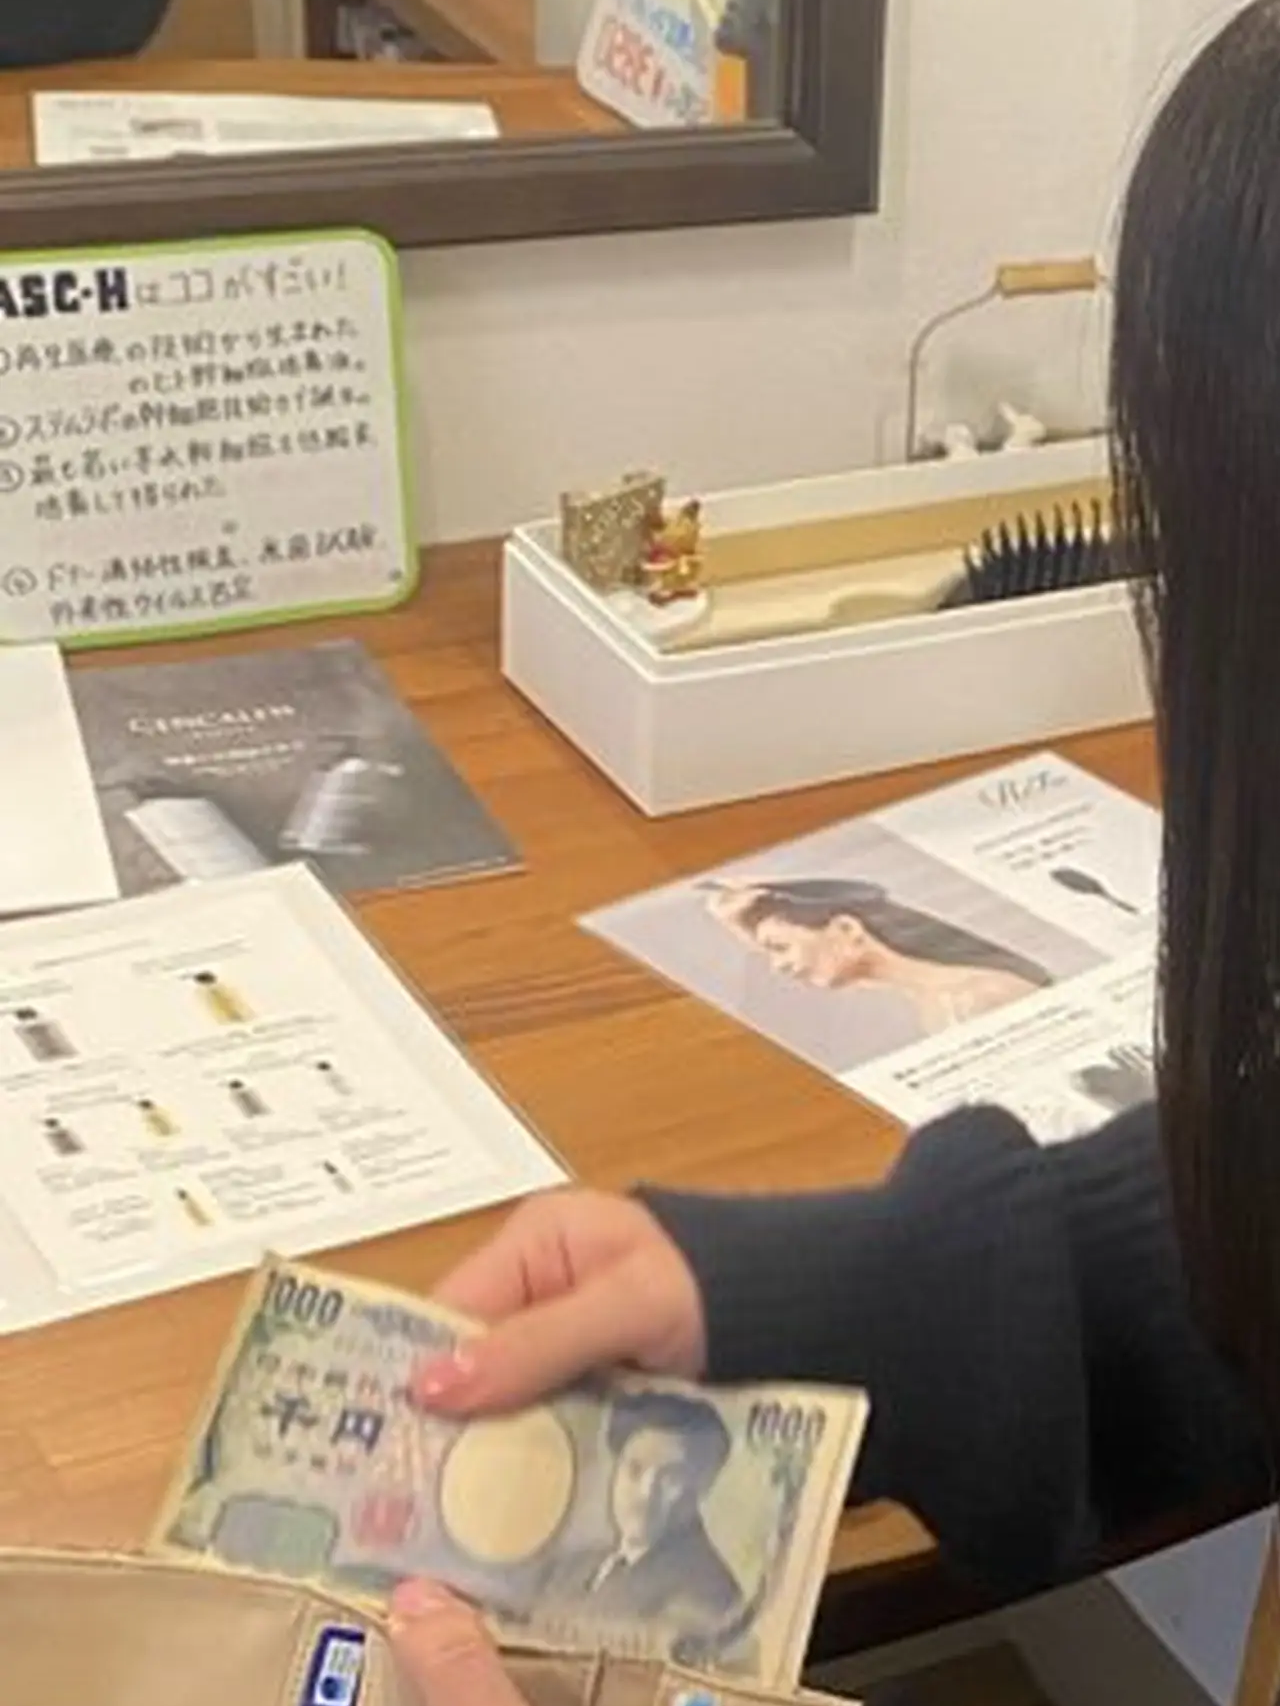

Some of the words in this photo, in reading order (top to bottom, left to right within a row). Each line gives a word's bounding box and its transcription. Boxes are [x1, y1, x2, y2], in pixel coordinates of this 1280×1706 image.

[262, 1270, 344, 1327] 1000
[260, 1391, 386, 1457] 千円
[745, 1401, 829, 1445] 1000
